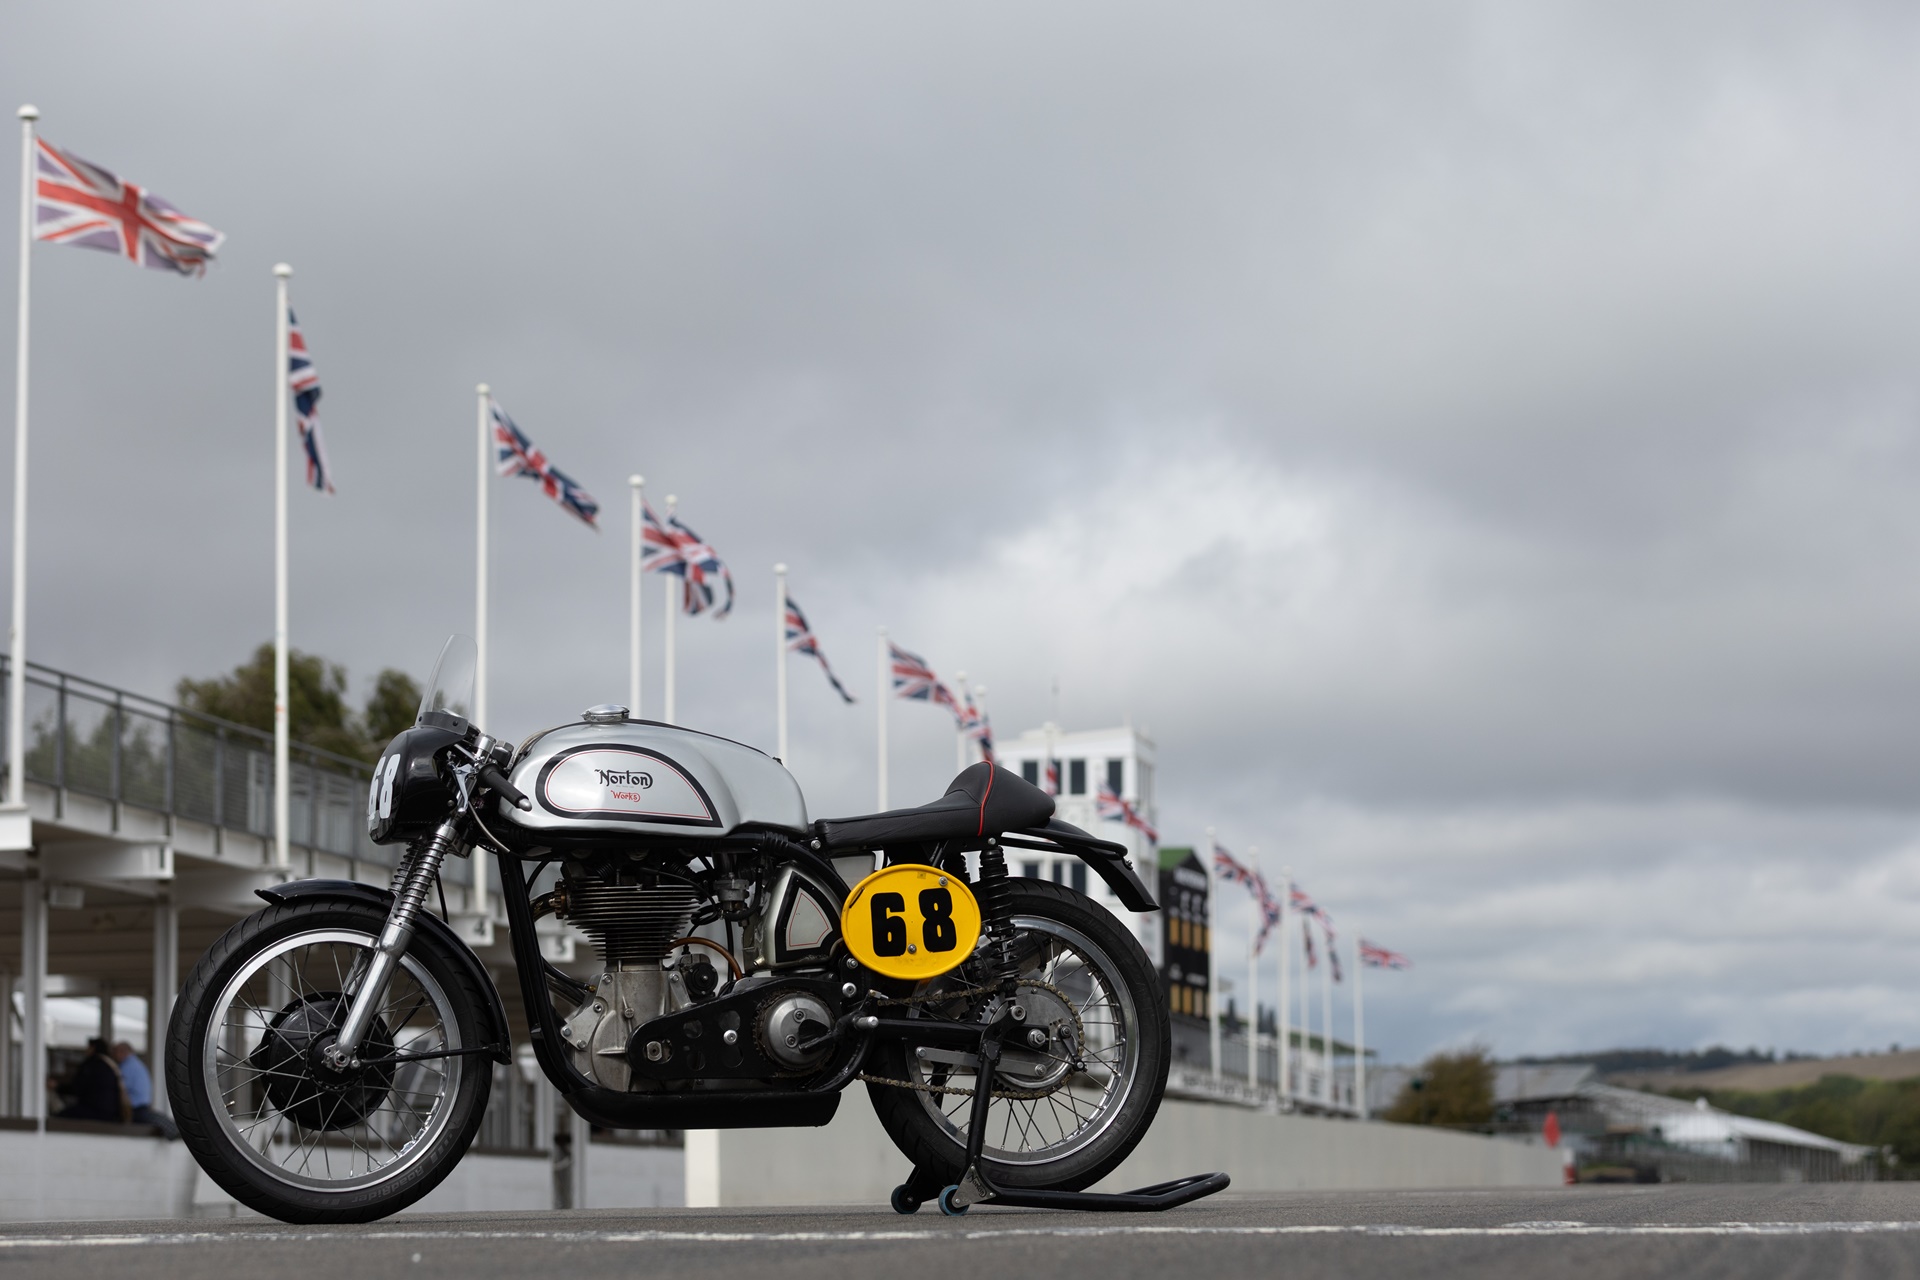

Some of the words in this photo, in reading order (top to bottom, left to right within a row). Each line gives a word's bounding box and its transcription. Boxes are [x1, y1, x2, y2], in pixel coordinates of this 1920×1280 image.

[368, 753, 401, 820] 68
[594, 769, 653, 789] Norton
[610, 790, 641, 803] Works
[870, 887, 957, 957] 68
[351, 1165, 425, 1204] RoadRider
